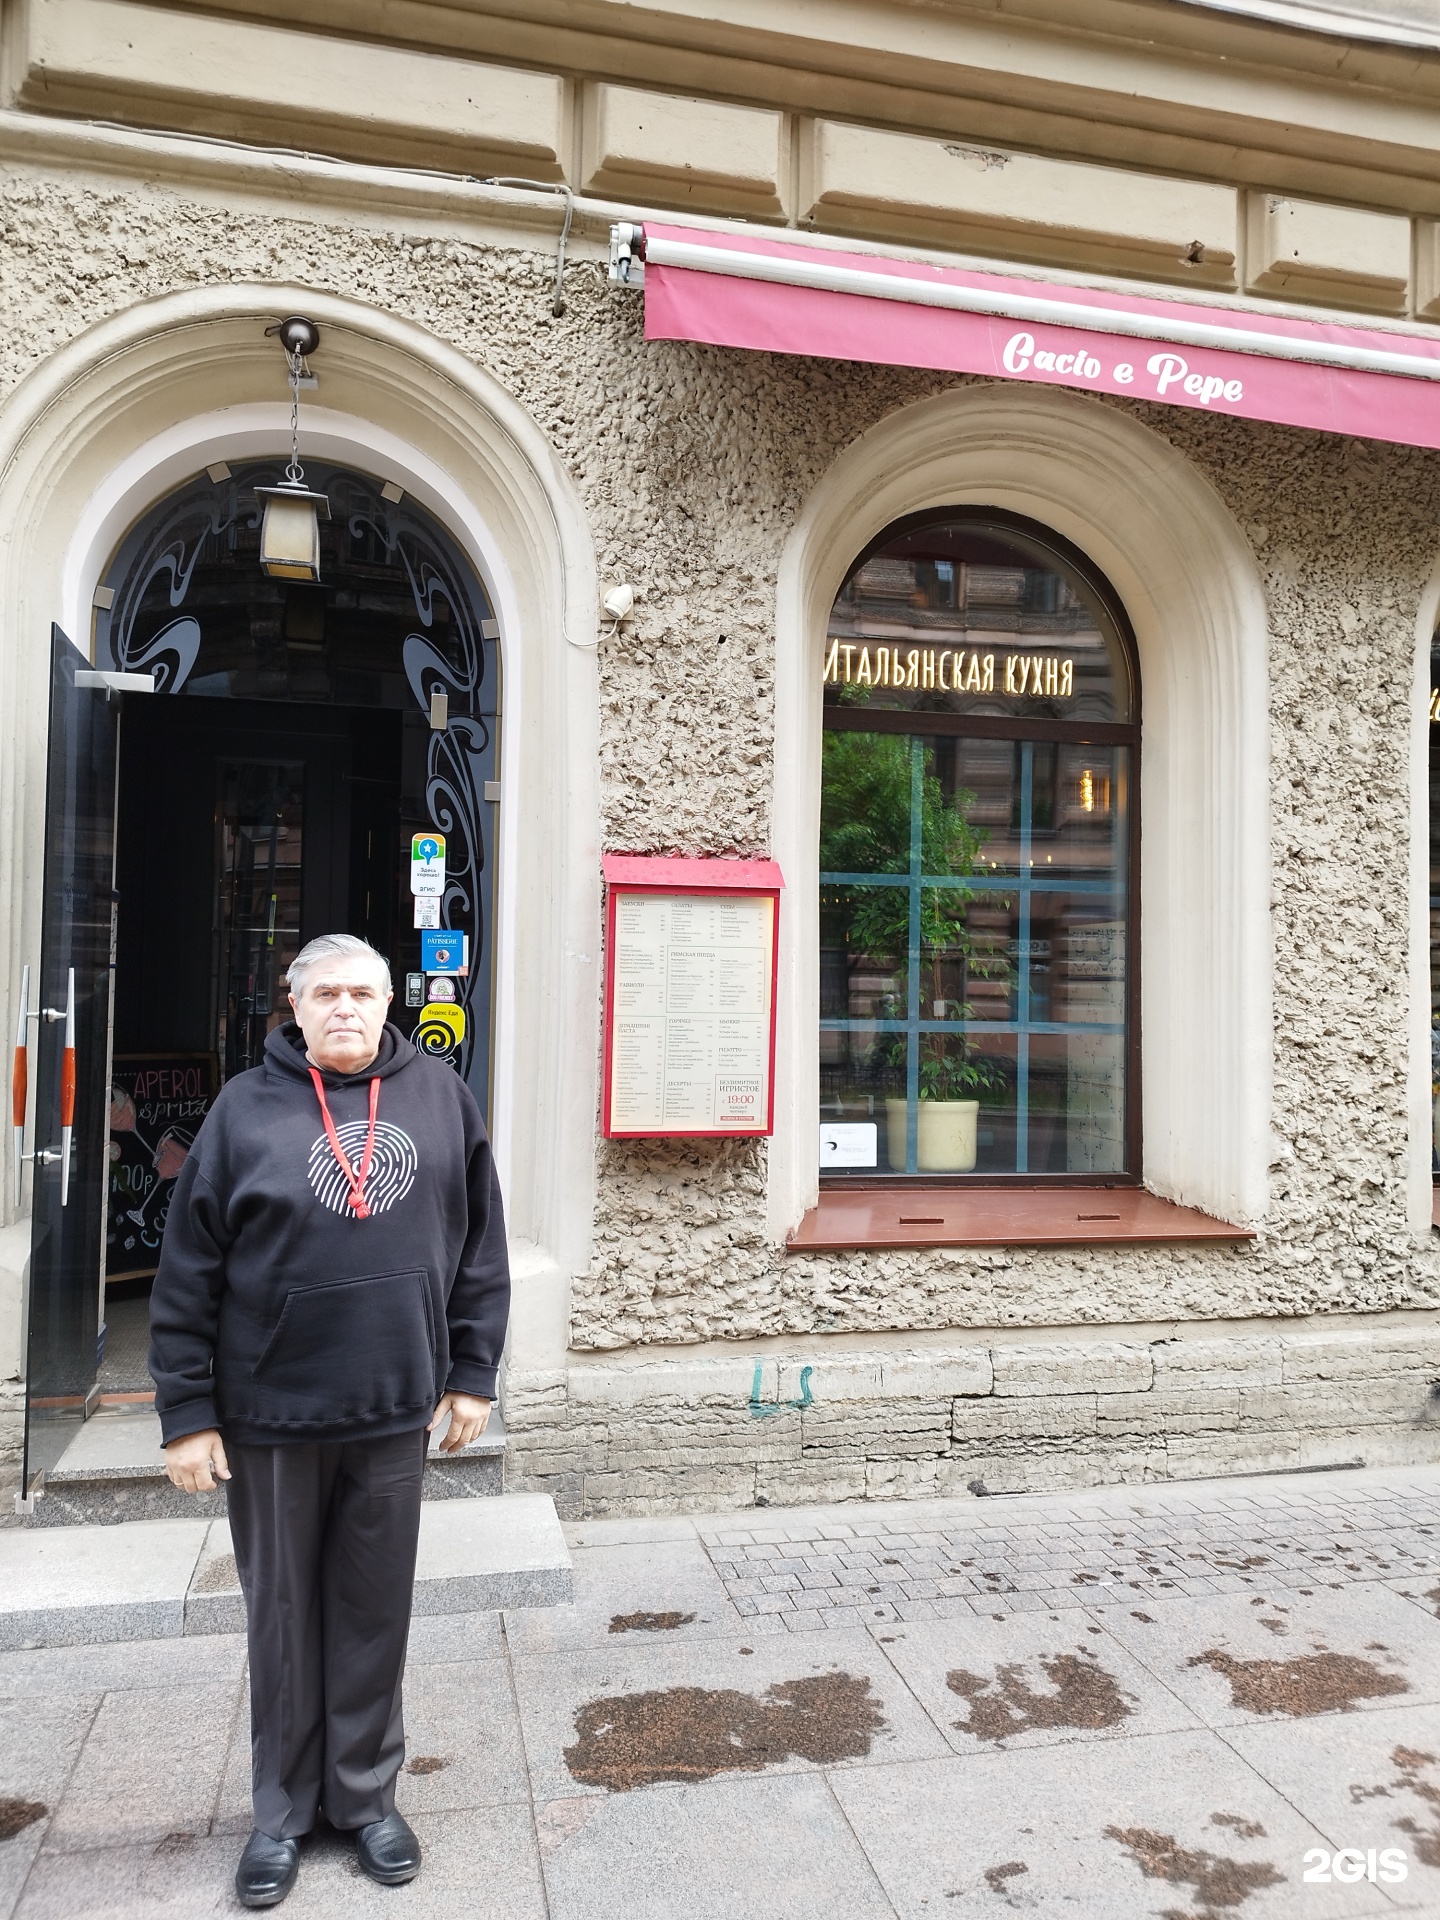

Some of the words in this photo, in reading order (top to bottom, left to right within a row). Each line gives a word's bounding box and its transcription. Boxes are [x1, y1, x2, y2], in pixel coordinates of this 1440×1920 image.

[1002, 332, 1101, 379] Cacio
[1112, 363, 1134, 384] e
[1146, 353, 1244, 405] Pepe
[823, 639, 995, 692] ИТАЛЬЯНСКАЯ
[1006, 654, 1074, 697] КУХНЯ
[133, 1068, 208, 1099] APEROL
[727, 1094, 755, 1104] 19:00
